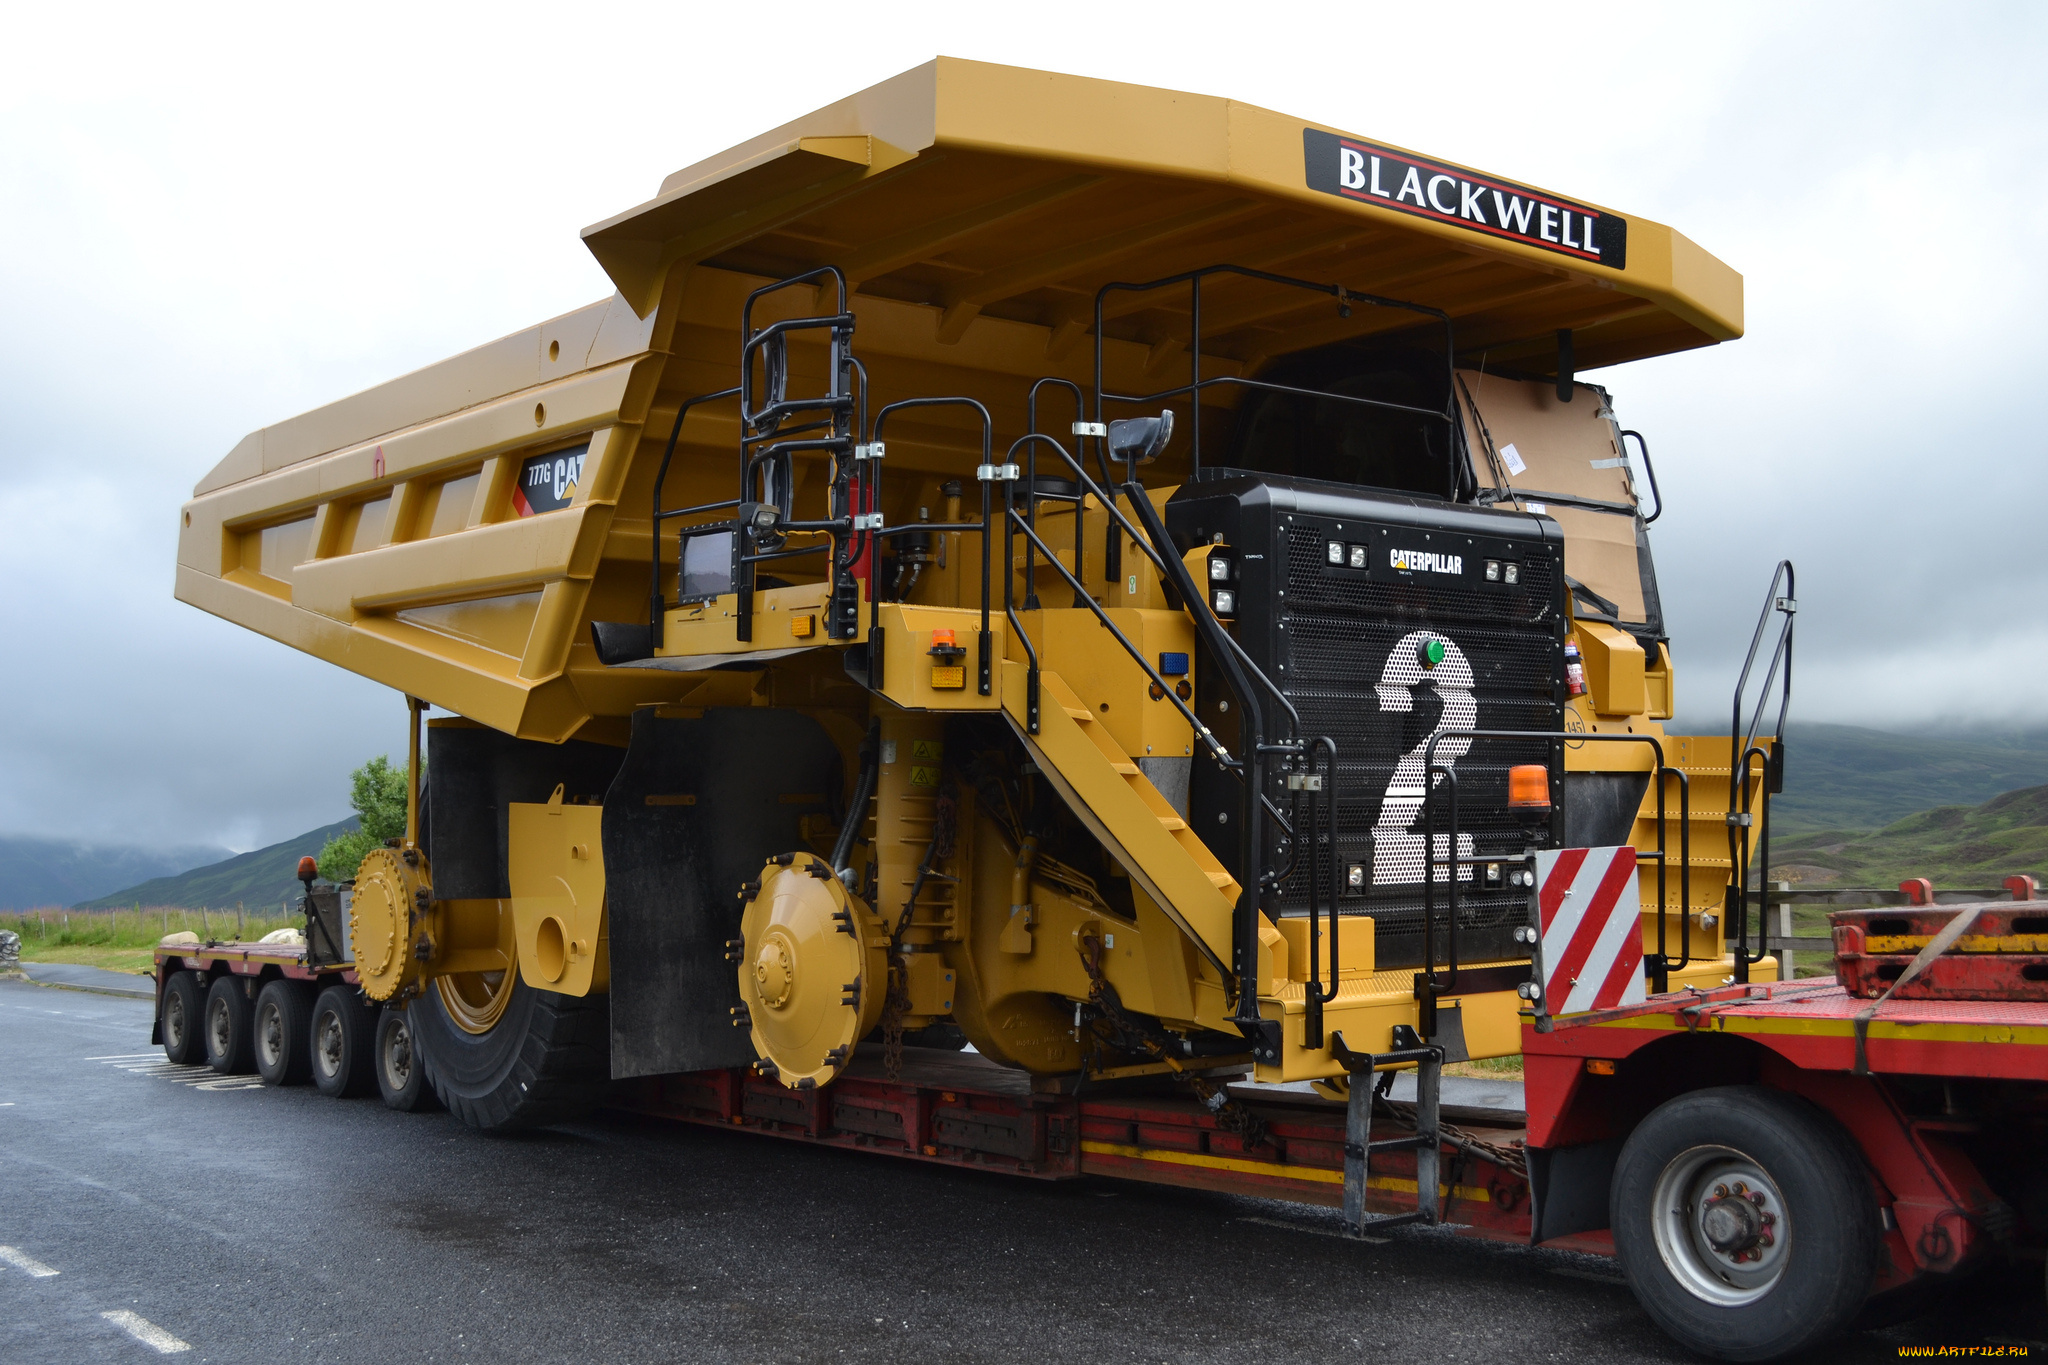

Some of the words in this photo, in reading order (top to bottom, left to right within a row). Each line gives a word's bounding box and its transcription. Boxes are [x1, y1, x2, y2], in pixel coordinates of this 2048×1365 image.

[1339, 147, 1600, 254] BLACKWELL
[528, 462, 551, 487] 777G
[1390, 548, 1462, 574] CATERPILLAR
[1370, 630, 1477, 885] 2
